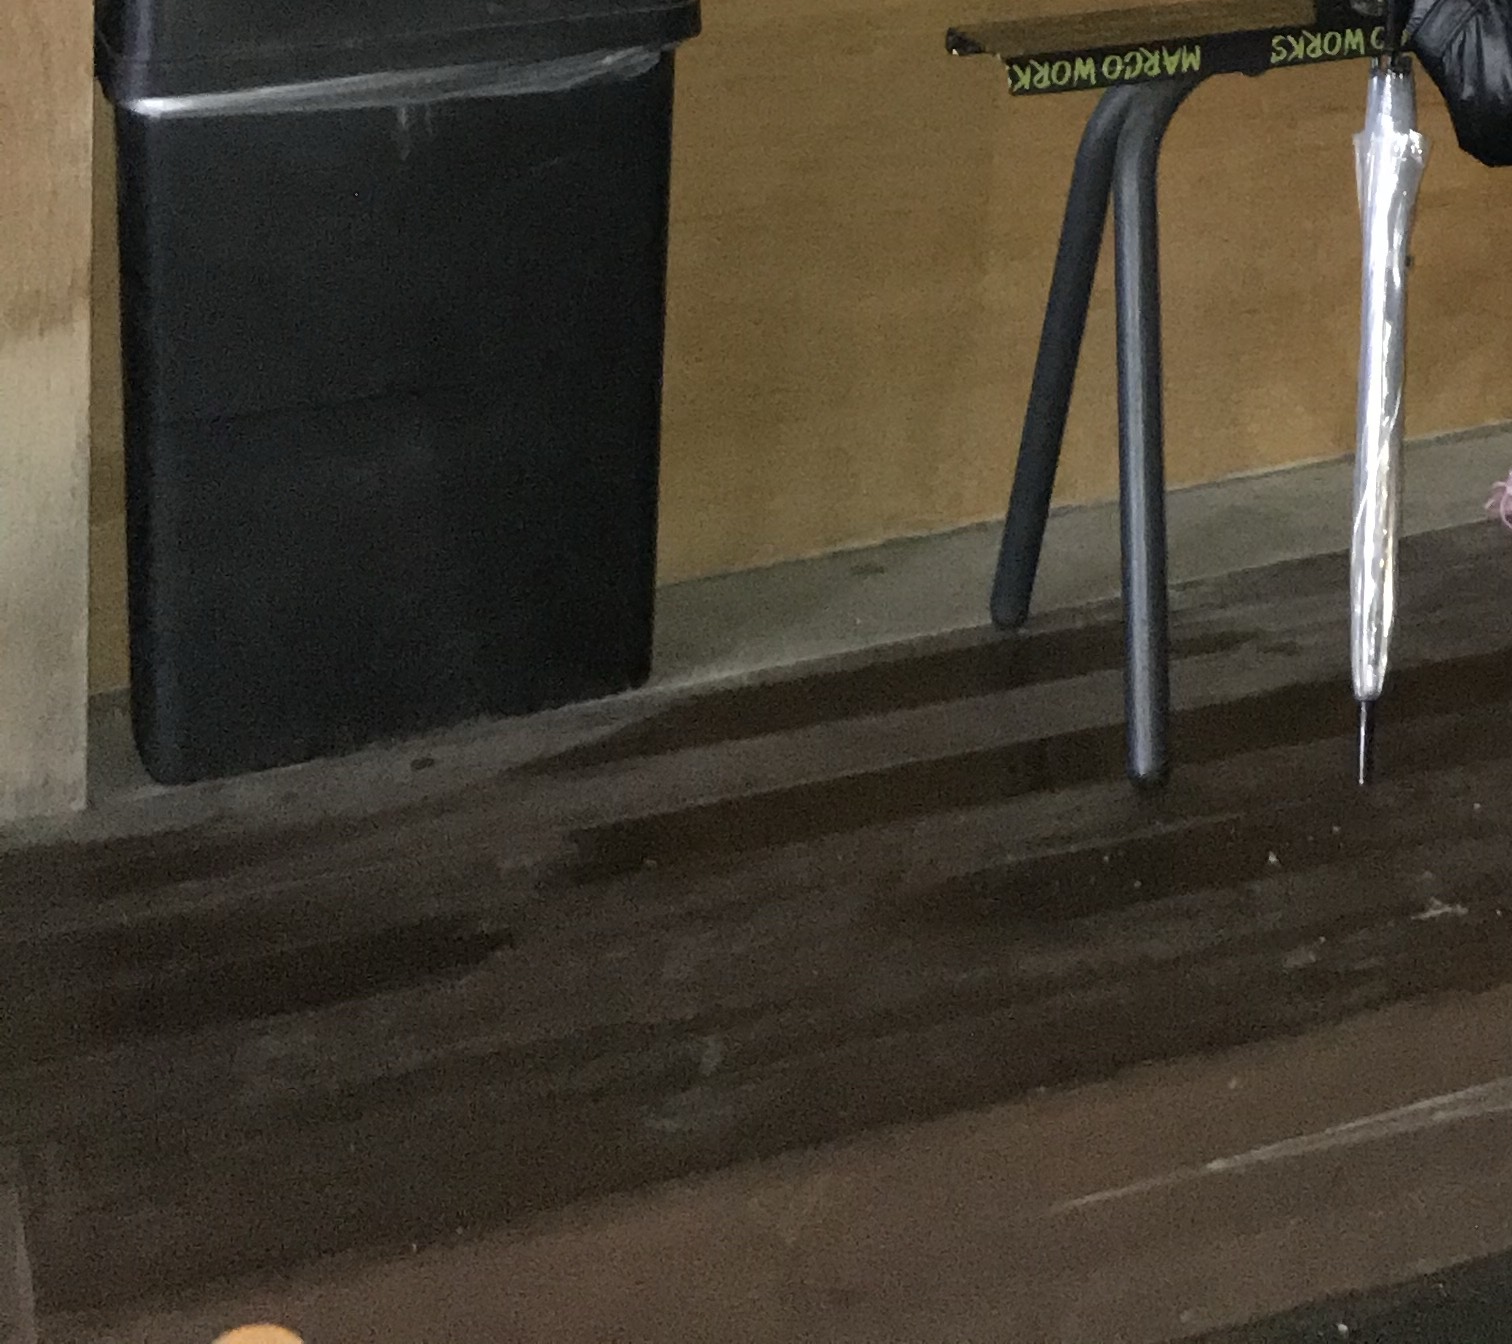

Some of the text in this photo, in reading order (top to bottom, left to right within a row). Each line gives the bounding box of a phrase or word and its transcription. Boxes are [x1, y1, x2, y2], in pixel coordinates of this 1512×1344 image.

[1270, 27, 1365, 64] WORKS
[1008, 44, 1202, 93] MARCO WORK
